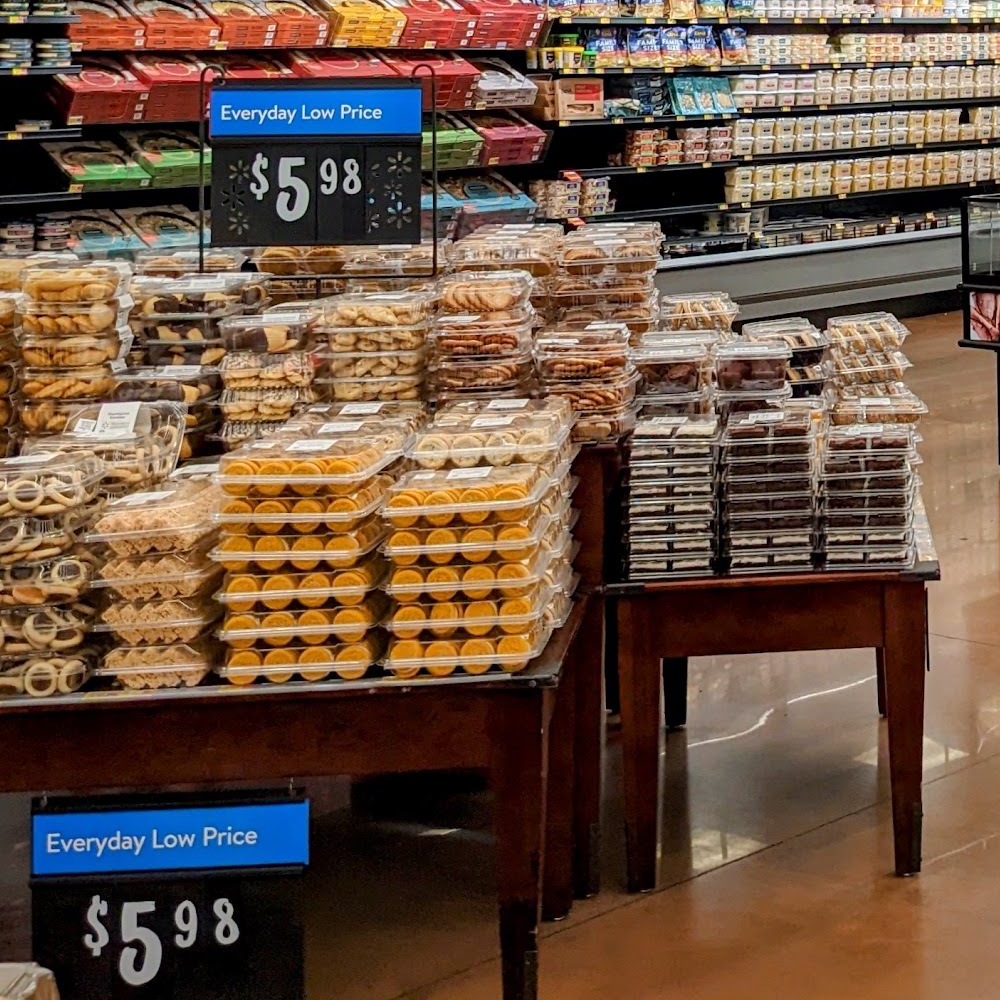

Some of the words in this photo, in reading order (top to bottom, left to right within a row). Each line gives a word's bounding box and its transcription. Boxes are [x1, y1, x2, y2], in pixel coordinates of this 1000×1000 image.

[220, 104, 297, 124] Everyday
[301, 105, 335, 120] Low
[340, 104, 383, 120] Price
[46, 830, 146, 857] Everyday
[152, 829, 195, 849] Low
[203, 826, 258, 847] Price
